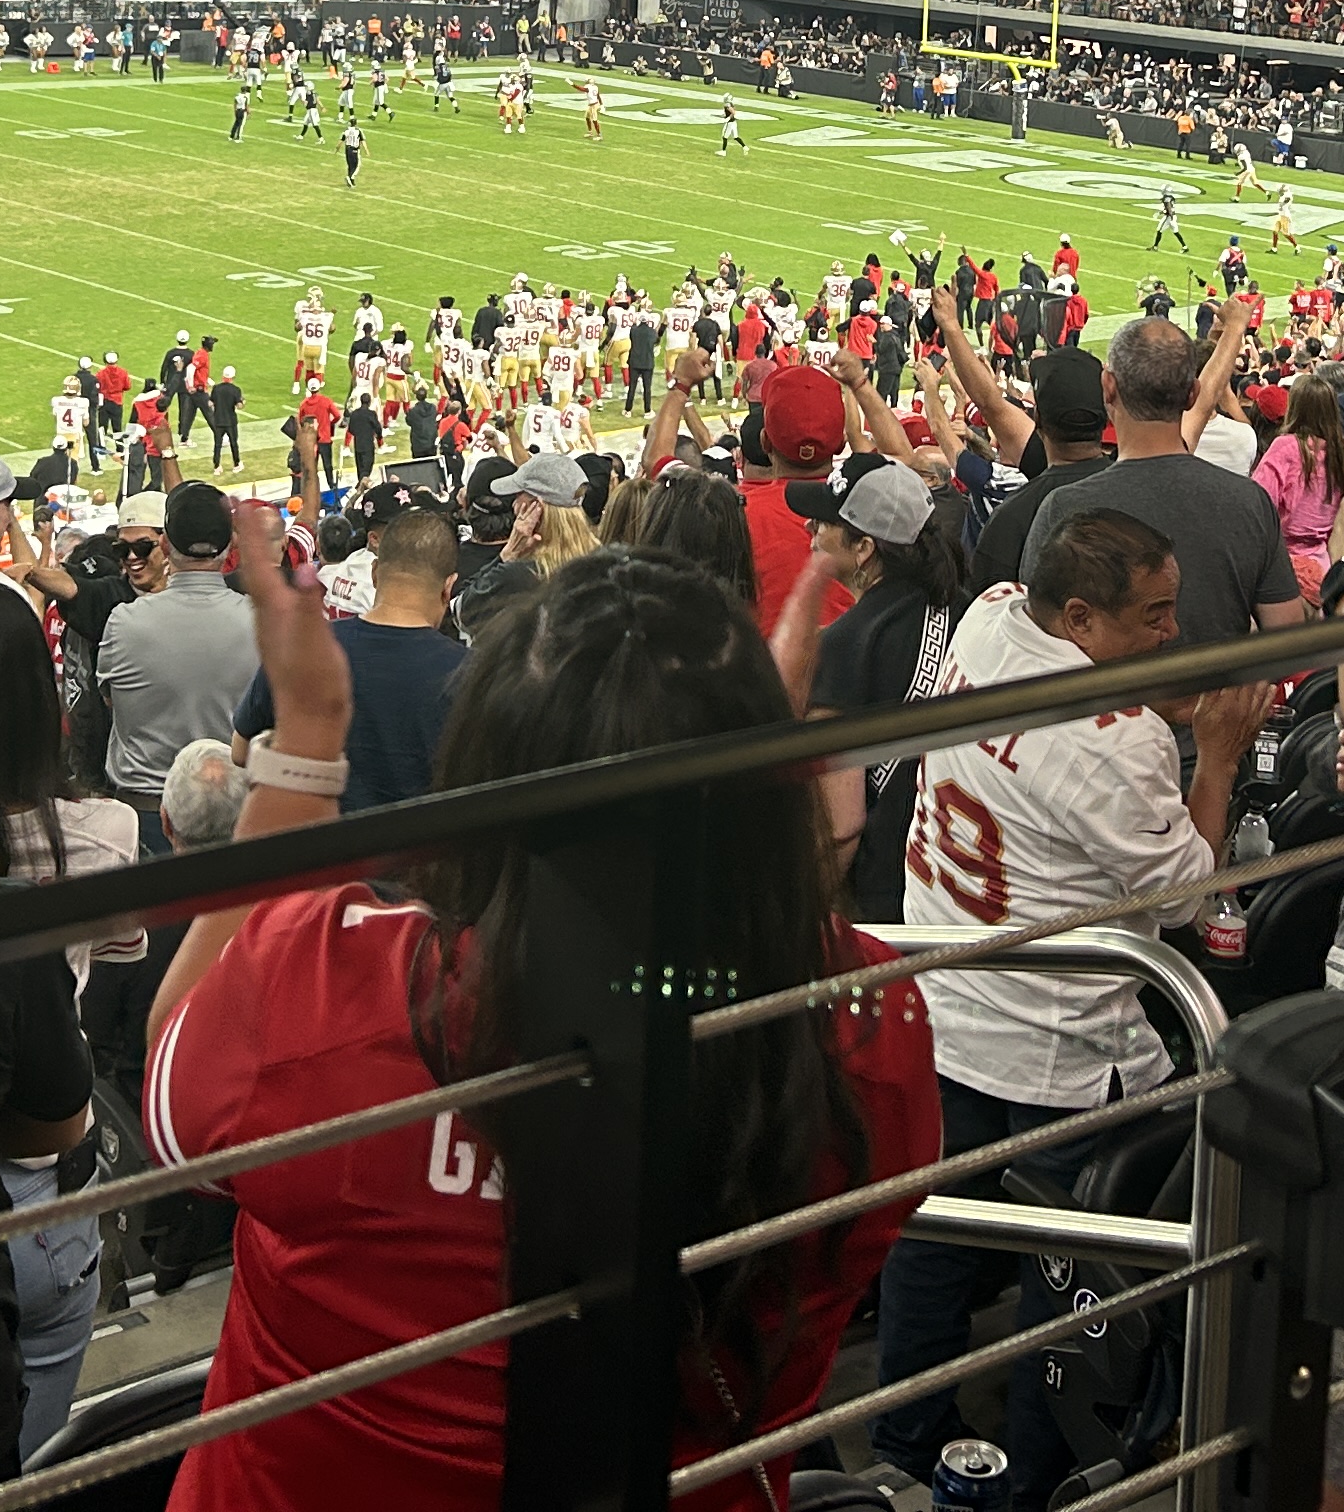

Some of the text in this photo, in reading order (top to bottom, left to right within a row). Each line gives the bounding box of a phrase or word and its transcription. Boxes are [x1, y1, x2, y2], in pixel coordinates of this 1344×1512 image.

[710, 8, 737, 18] CLUB
[304, 321, 324, 339] 66
[552, 354, 571, 372] 89
[62, 408, 74, 427] 4
[1046, 1359, 1063, 1390] 31
